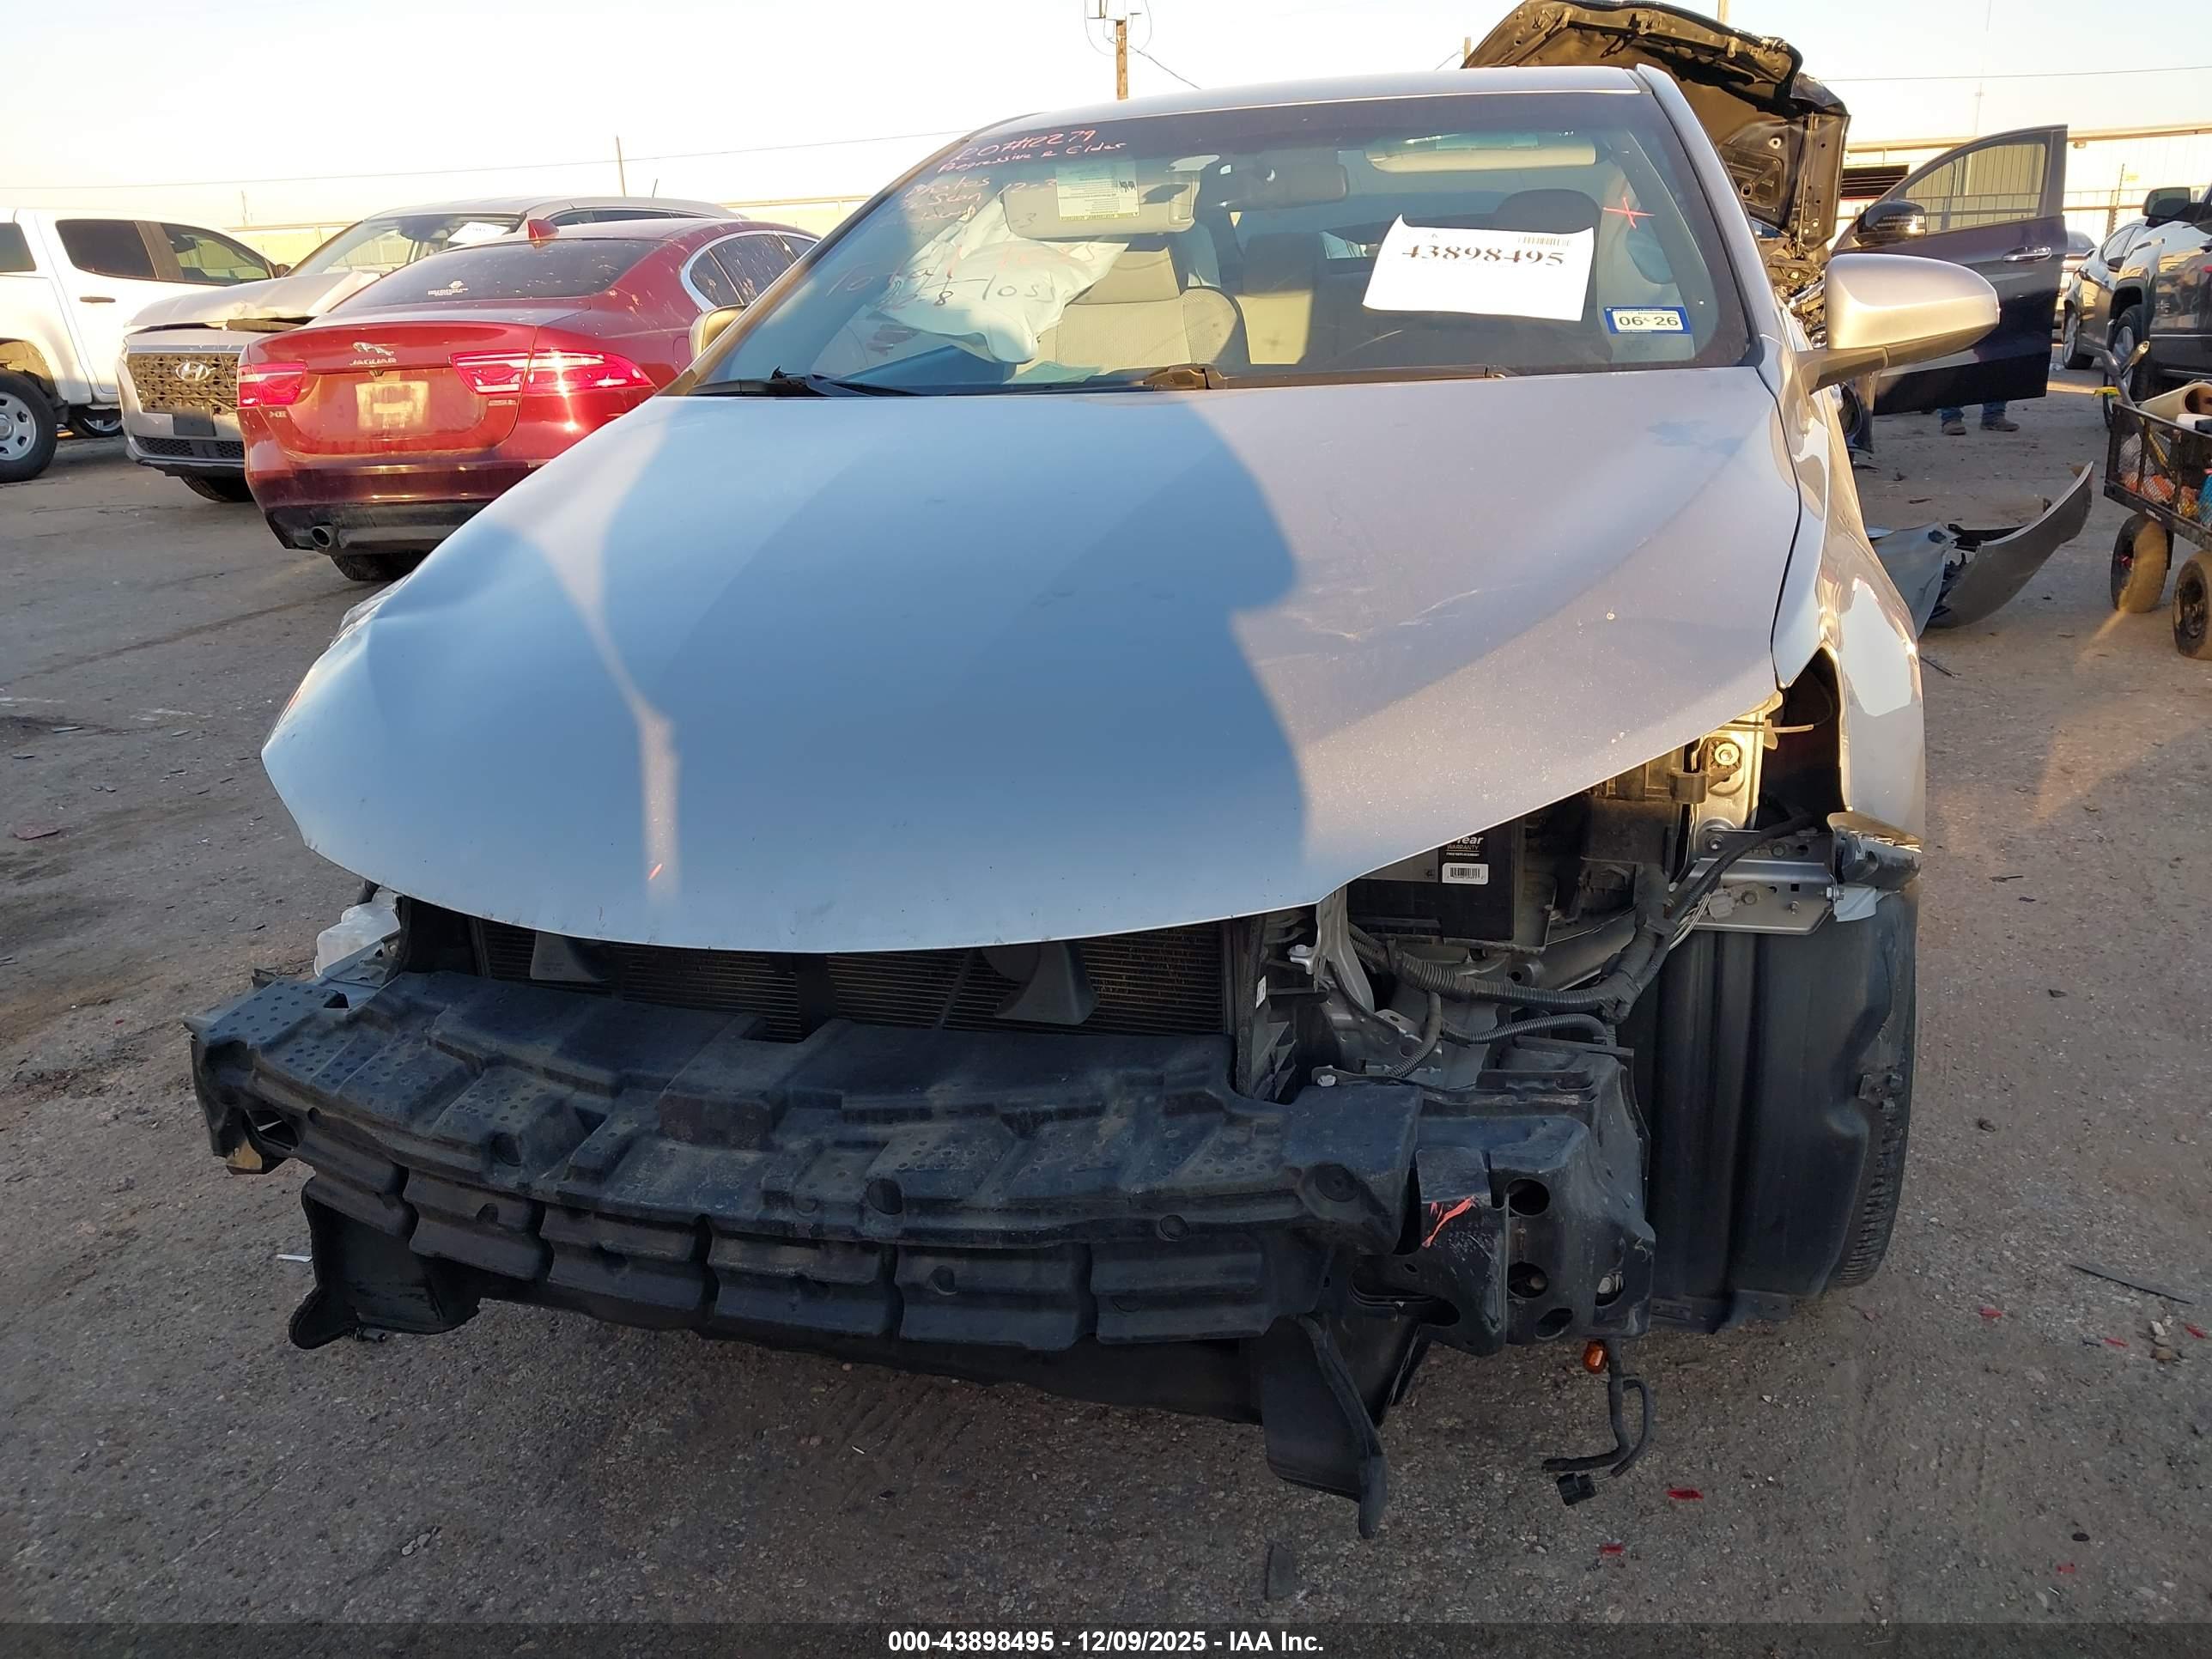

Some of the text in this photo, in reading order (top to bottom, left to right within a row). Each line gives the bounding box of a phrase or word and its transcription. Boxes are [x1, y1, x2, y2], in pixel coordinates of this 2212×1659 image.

[1401, 245, 1565, 266] 43898495
[1619, 316, 1679, 326] 06 26
[349, 357, 398, 366] JAGUAR
